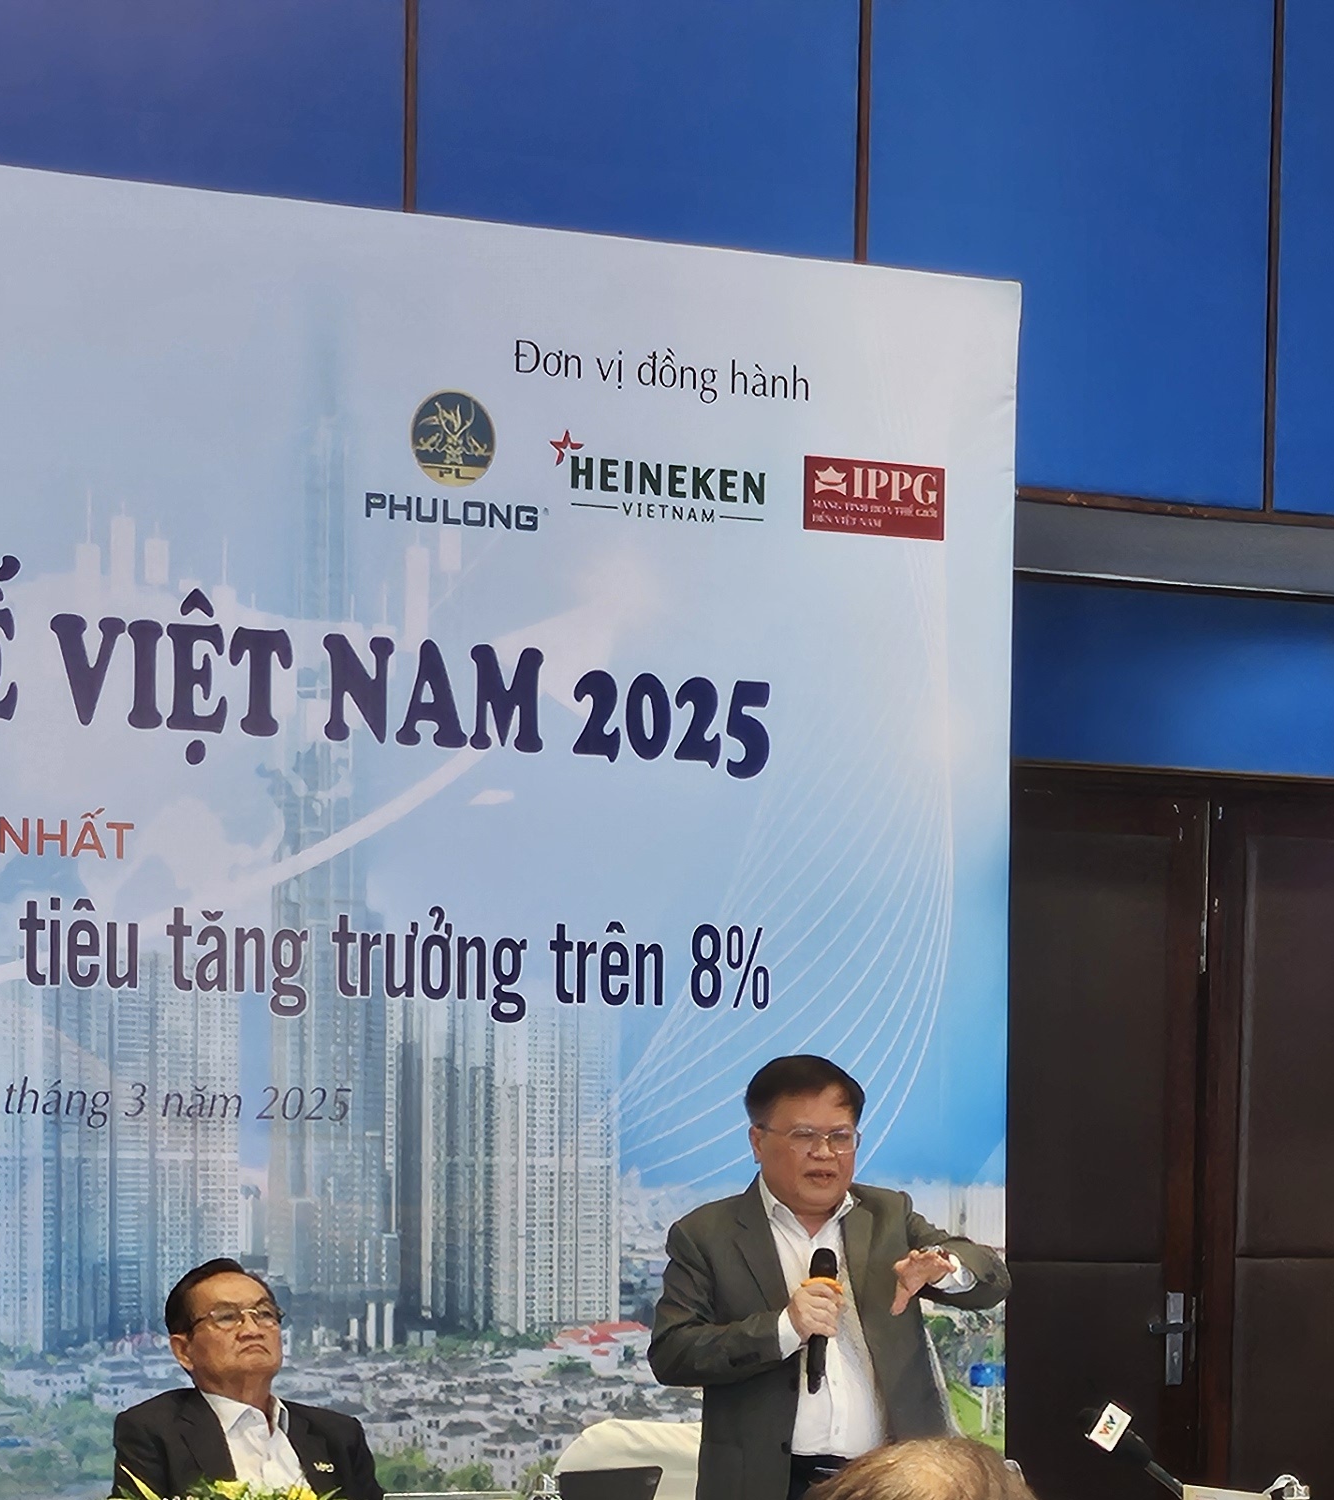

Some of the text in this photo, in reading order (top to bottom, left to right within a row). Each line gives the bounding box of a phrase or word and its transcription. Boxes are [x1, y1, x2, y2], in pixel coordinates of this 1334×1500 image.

[514, 339, 810, 404] Đơn vị đồng hành
[439, 467, 476, 480] PL
[570, 456, 766, 505] HEINEKEN
[853, 466, 938, 505] IPPG
[364, 492, 539, 531] PHULONG
[622, 503, 715, 524] VIETNAM
[50, 588, 293, 765] VIỆT
[322, 633, 544, 753] NAM
[572, 670, 770, 780] 2025
[19, 897, 139, 989] tiêu
[166, 905, 308, 1017] tăng
[332, 905, 527, 1023] trưởng
[550, 920, 664, 1006] trên
[690, 924, 770, 1010] 8%
[4, 1077, 110, 1129] tháng
[123, 1082, 146, 1119] 3
[162, 1085, 242, 1120] năm
[256, 1086, 353, 1124] 2025
